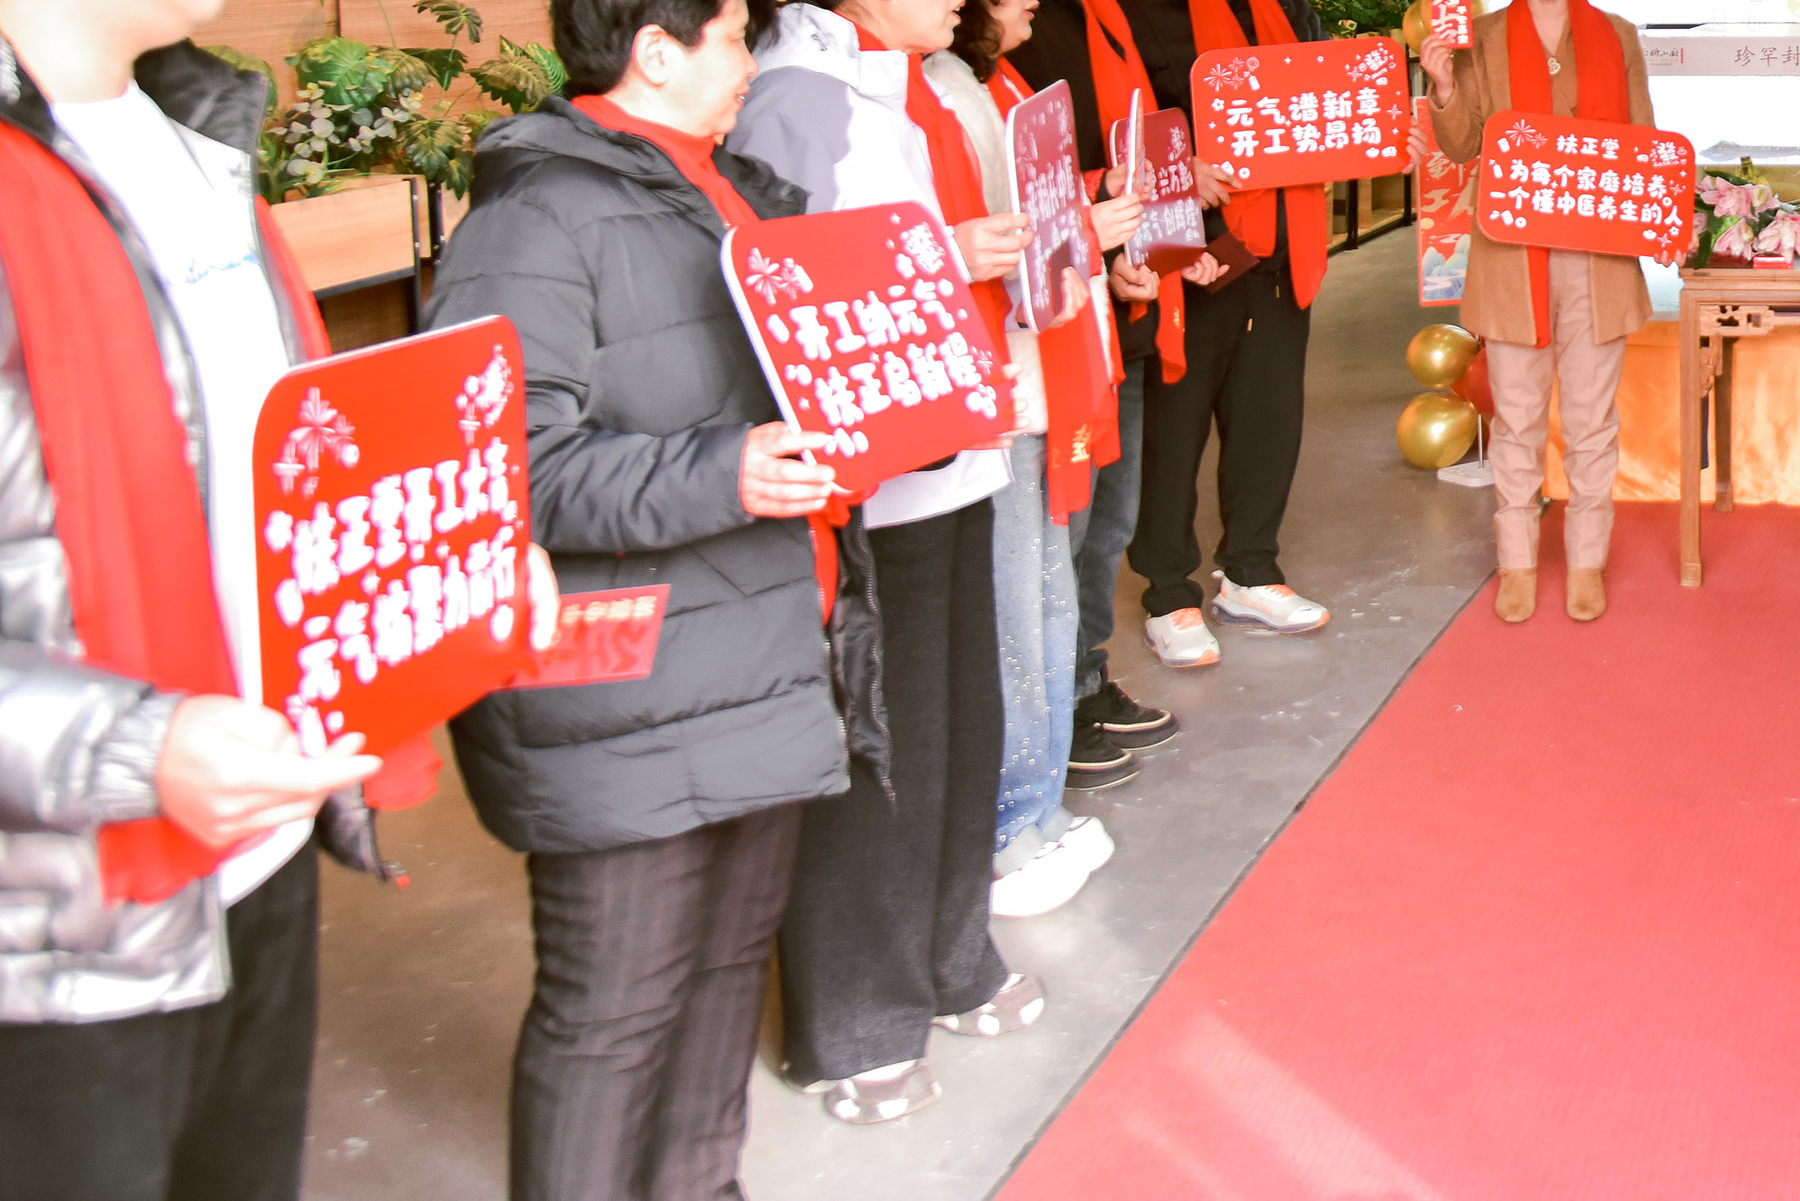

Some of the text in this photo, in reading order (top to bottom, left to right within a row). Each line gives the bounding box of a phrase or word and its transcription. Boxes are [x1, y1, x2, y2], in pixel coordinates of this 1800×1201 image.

[1226, 86, 1382, 126] 元气谱新章
[1230, 118, 1382, 158] 开工势昂扬
[1556, 134, 1620, 160] 扶正堂
[1509, 158, 1667, 199] 为每个家庭培养
[1489, 185, 1683, 227] 一个懂中医养生的人
